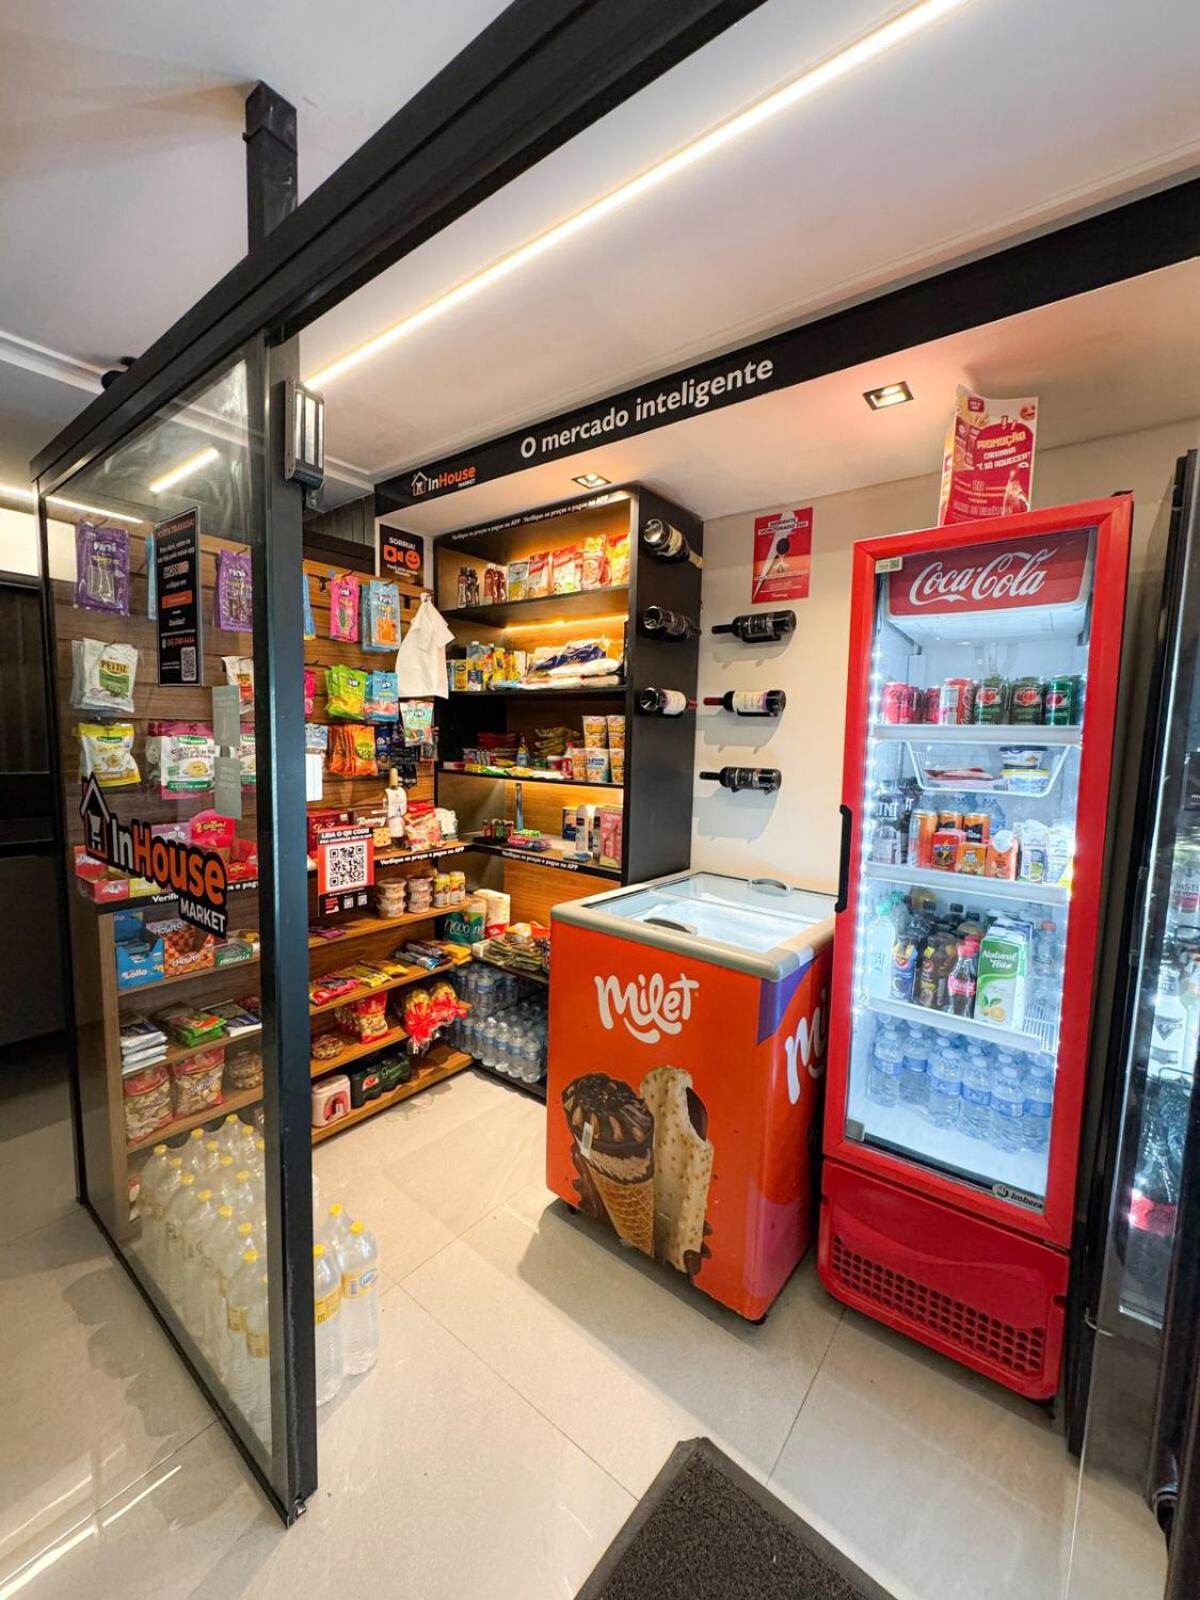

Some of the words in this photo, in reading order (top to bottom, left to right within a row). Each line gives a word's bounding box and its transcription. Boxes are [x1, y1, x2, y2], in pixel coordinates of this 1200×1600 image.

[520, 437, 536, 458] O
[541, 408, 629, 453] mercado
[635, 359, 774, 422] inteligente
[428, 466, 477, 492] InHouse
[909, 547, 1060, 606] Coca-Cola
[111, 817, 225, 905] InHouse
[180, 897, 226, 933] MARKET
[983, 948, 1018, 961] Natural
[594, 973, 699, 1044] Milet
